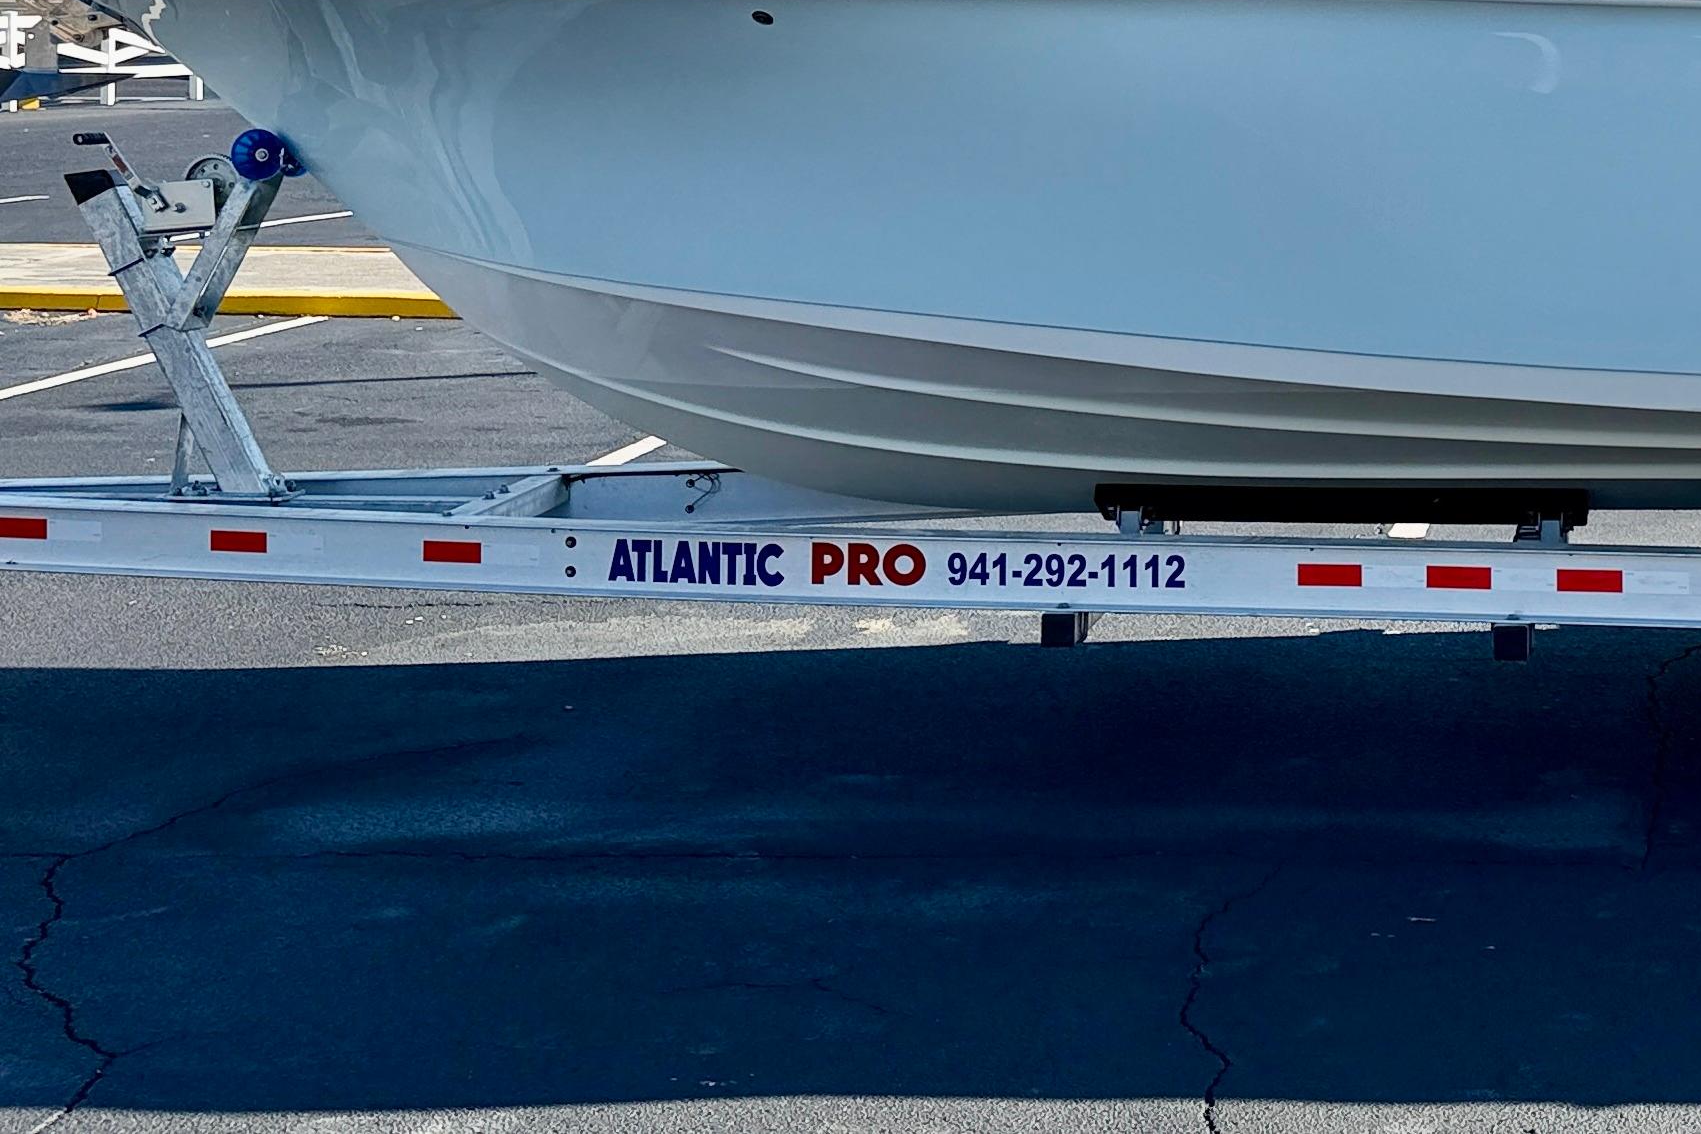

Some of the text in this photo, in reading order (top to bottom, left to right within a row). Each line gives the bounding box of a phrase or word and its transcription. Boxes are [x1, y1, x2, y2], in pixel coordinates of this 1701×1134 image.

[608, 538, 1186, 588] ATLANTIC PRO 941-292-1112
